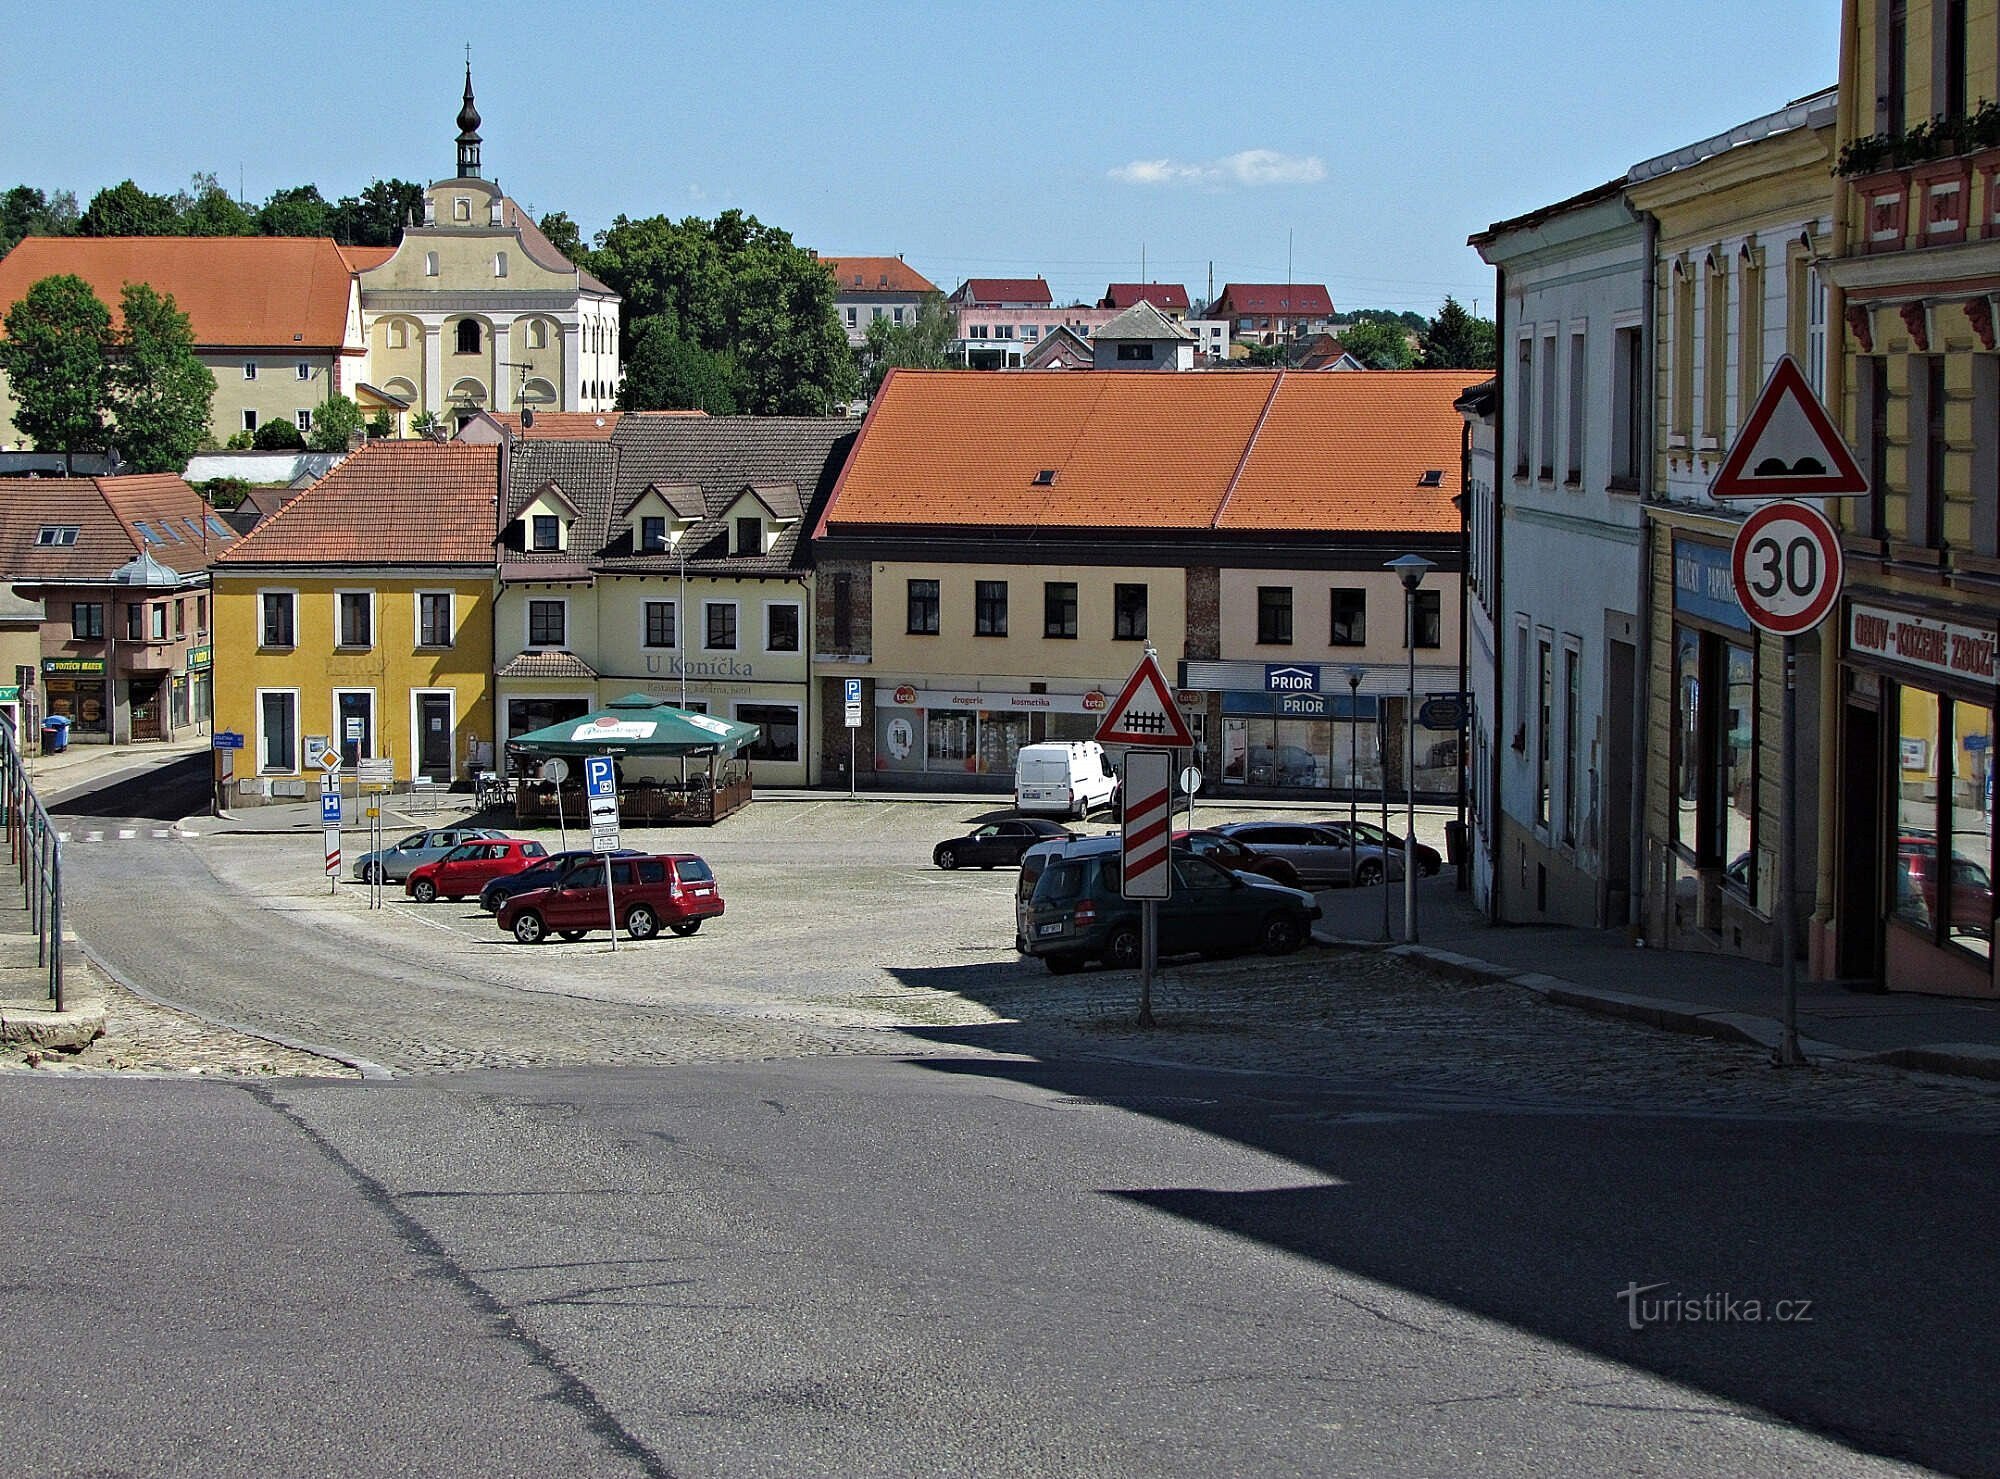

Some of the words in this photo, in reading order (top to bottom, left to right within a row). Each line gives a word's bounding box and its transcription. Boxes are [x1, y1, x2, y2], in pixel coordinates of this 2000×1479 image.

[1752, 537, 1817, 597] 30
[1855, 613, 1889, 652] OBUV
[1896, 618, 1948, 667] KOŽENÉ
[1950, 632, 1995, 677] ZBOŽÍ
[646, 656, 662, 674] U
[670, 656, 753, 677] Koníčka
[848, 682, 858, 696] P
[1271, 676, 1313, 690] PRIOR
[952, 695, 984, 706] drogerie
[1011, 696, 1051, 708] kosmetika
[1283, 699, 1325, 713] PRIOR
[591, 762, 608, 785] P
[324, 797, 339, 810] H
